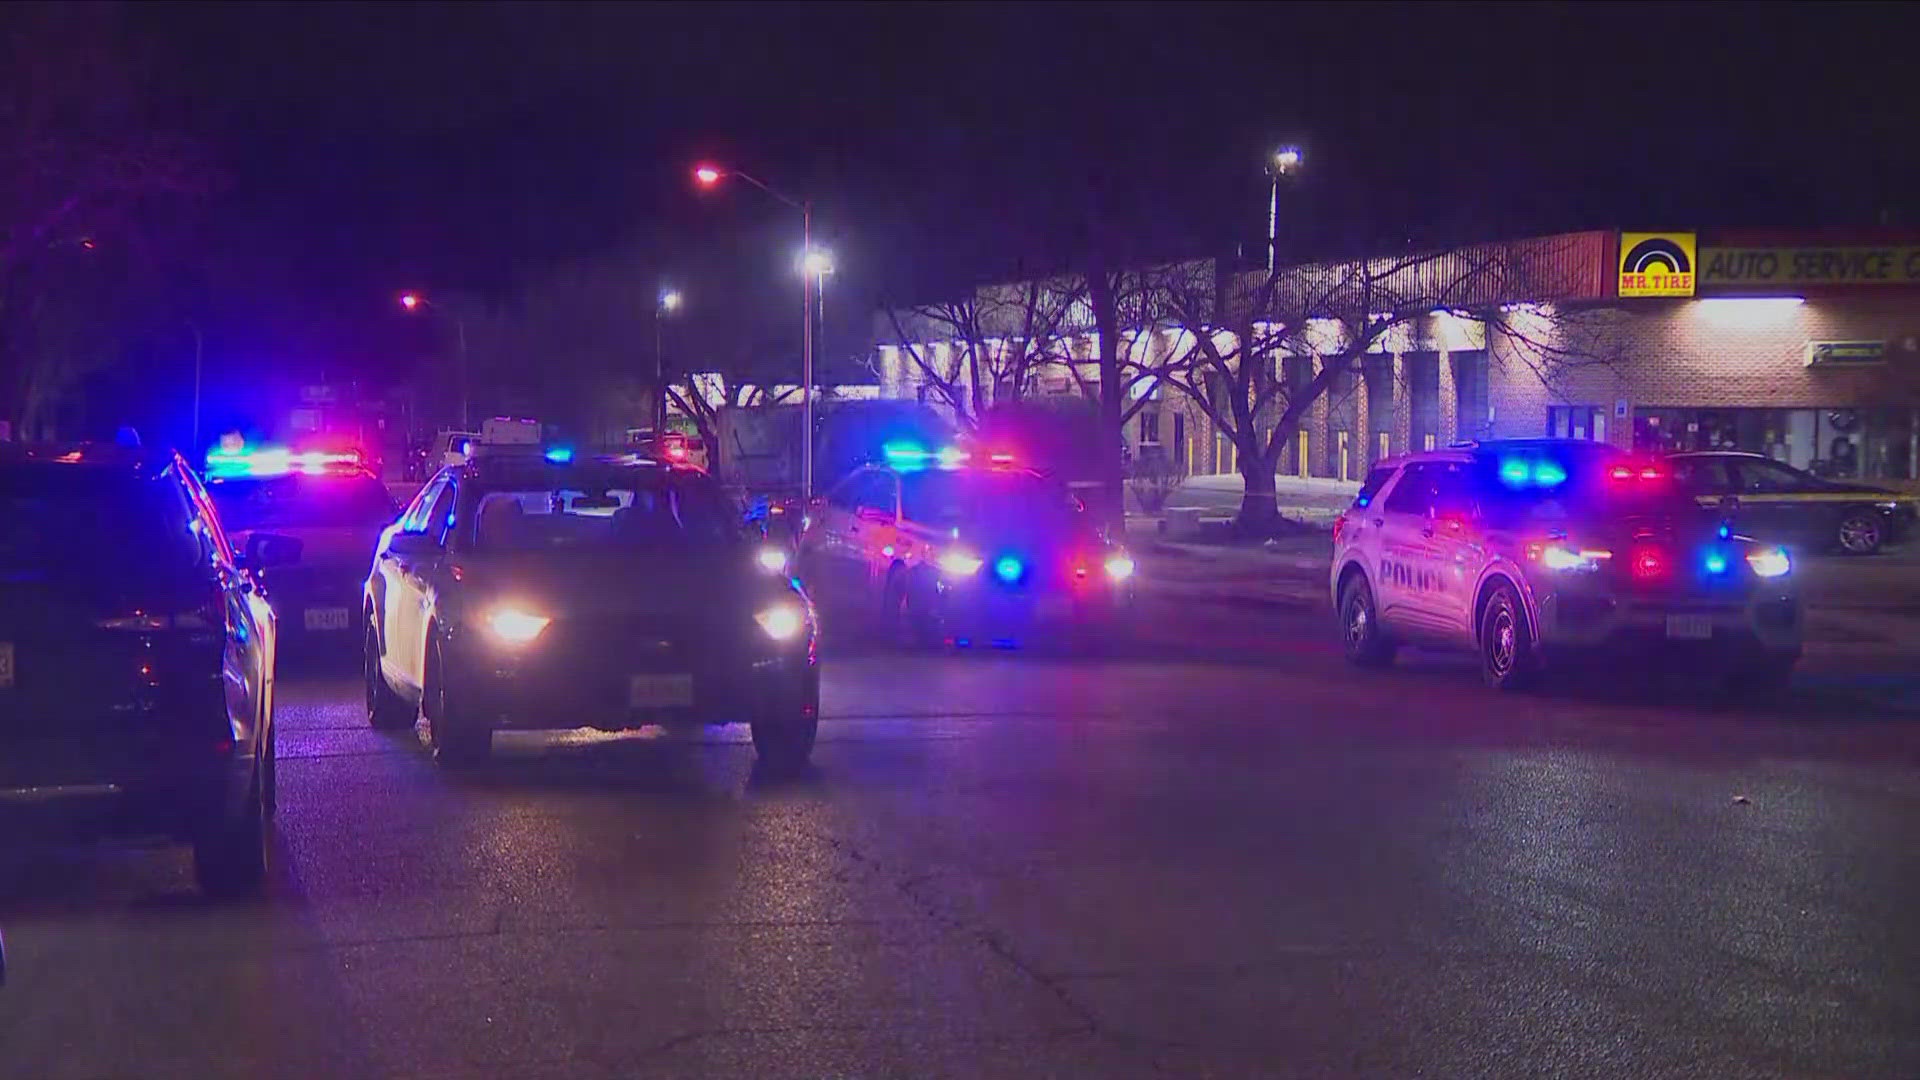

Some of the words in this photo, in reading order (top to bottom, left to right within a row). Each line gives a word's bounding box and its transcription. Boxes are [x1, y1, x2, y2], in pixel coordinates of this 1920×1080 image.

[1705, 252, 1778, 279] AUTO
[1791, 251, 1891, 279] SERVICE
[1653, 275, 1692, 289] TIRE
